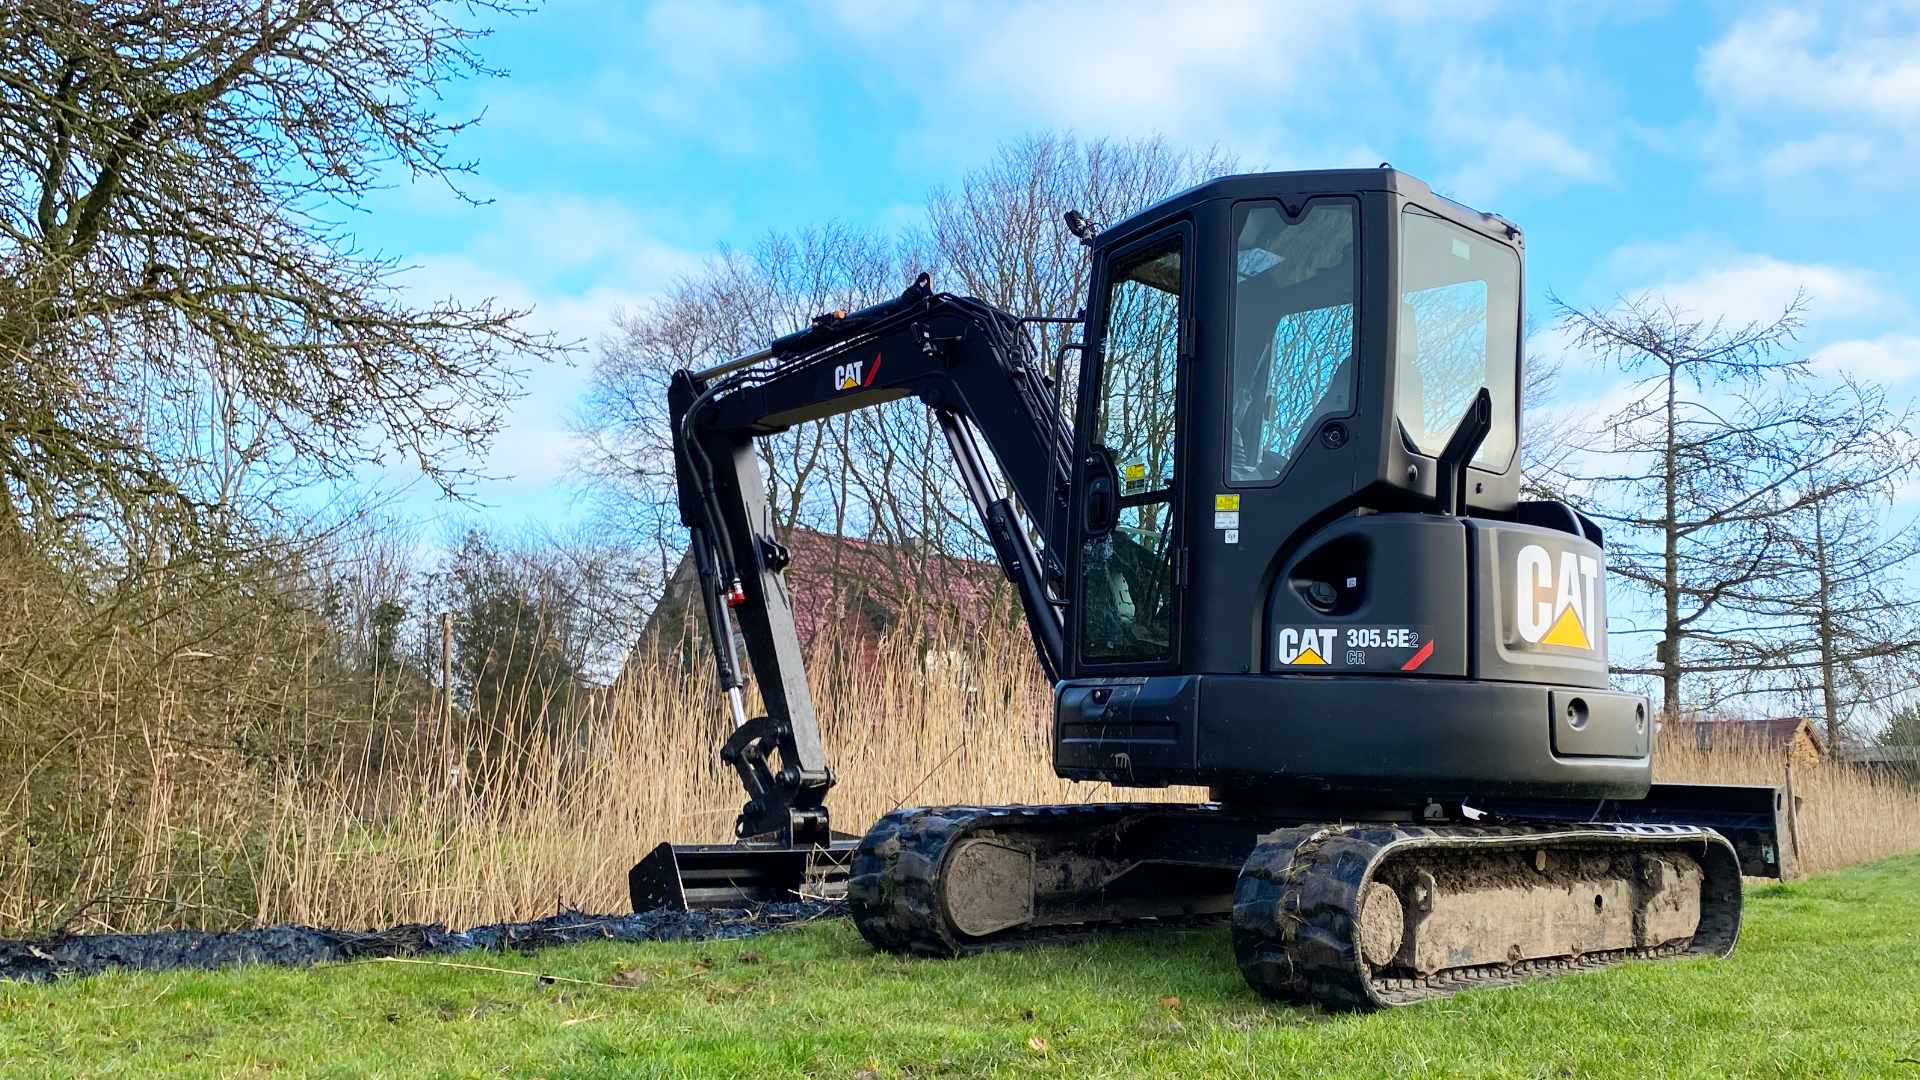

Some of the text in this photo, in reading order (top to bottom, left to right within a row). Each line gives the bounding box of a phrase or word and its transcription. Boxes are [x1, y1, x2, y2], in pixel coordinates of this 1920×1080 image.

[835, 360, 863, 390] CAT
[1517, 545, 1597, 650] CAT
[1279, 628, 1338, 665] CAT
[1347, 628, 1419, 648] 305.5E2
[1346, 650, 1366, 665] CR
